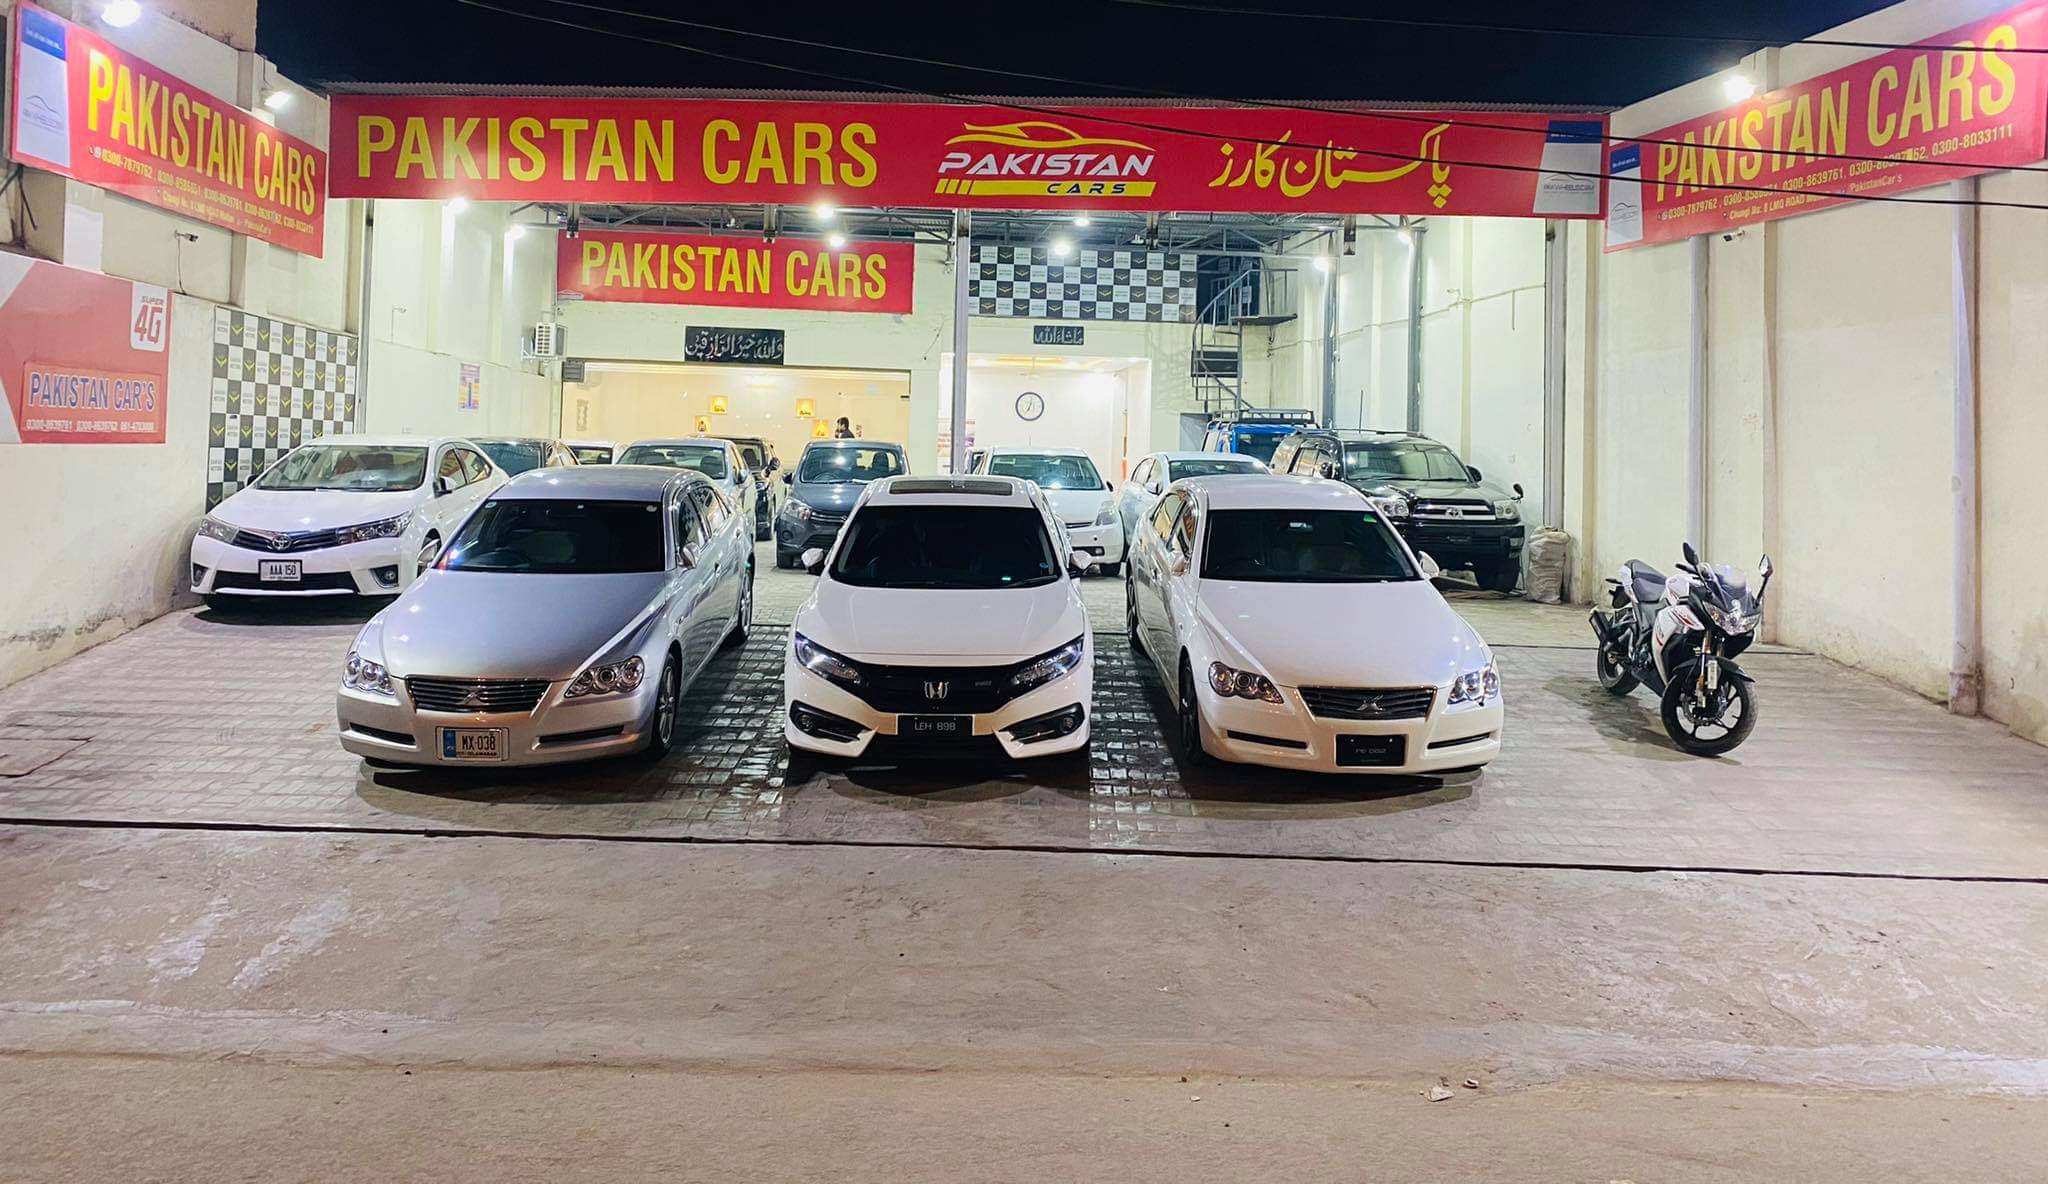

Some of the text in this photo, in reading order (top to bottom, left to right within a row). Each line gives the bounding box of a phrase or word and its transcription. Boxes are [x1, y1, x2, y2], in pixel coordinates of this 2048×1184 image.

[88, 48, 316, 216] PAKISTAN CARS
[1656, 24, 2018, 202] PAKISTAN CARS
[357, 115, 877, 187] PAKISTAN CARS
[1932, 123, 2013, 156] 0300-8033111
[938, 152, 1155, 176] PAKISTAN
[1208, 119, 1452, 208] پاکستان کارز
[1047, 183, 1126, 194] CARS
[581, 240, 887, 300] PAKISTAN CARS
[141, 295, 164, 305] SUPER
[134, 304, 163, 344] 4G
[28, 372, 156, 412] PAKISTAN CAR'S
[937, 721, 956, 731] 898
